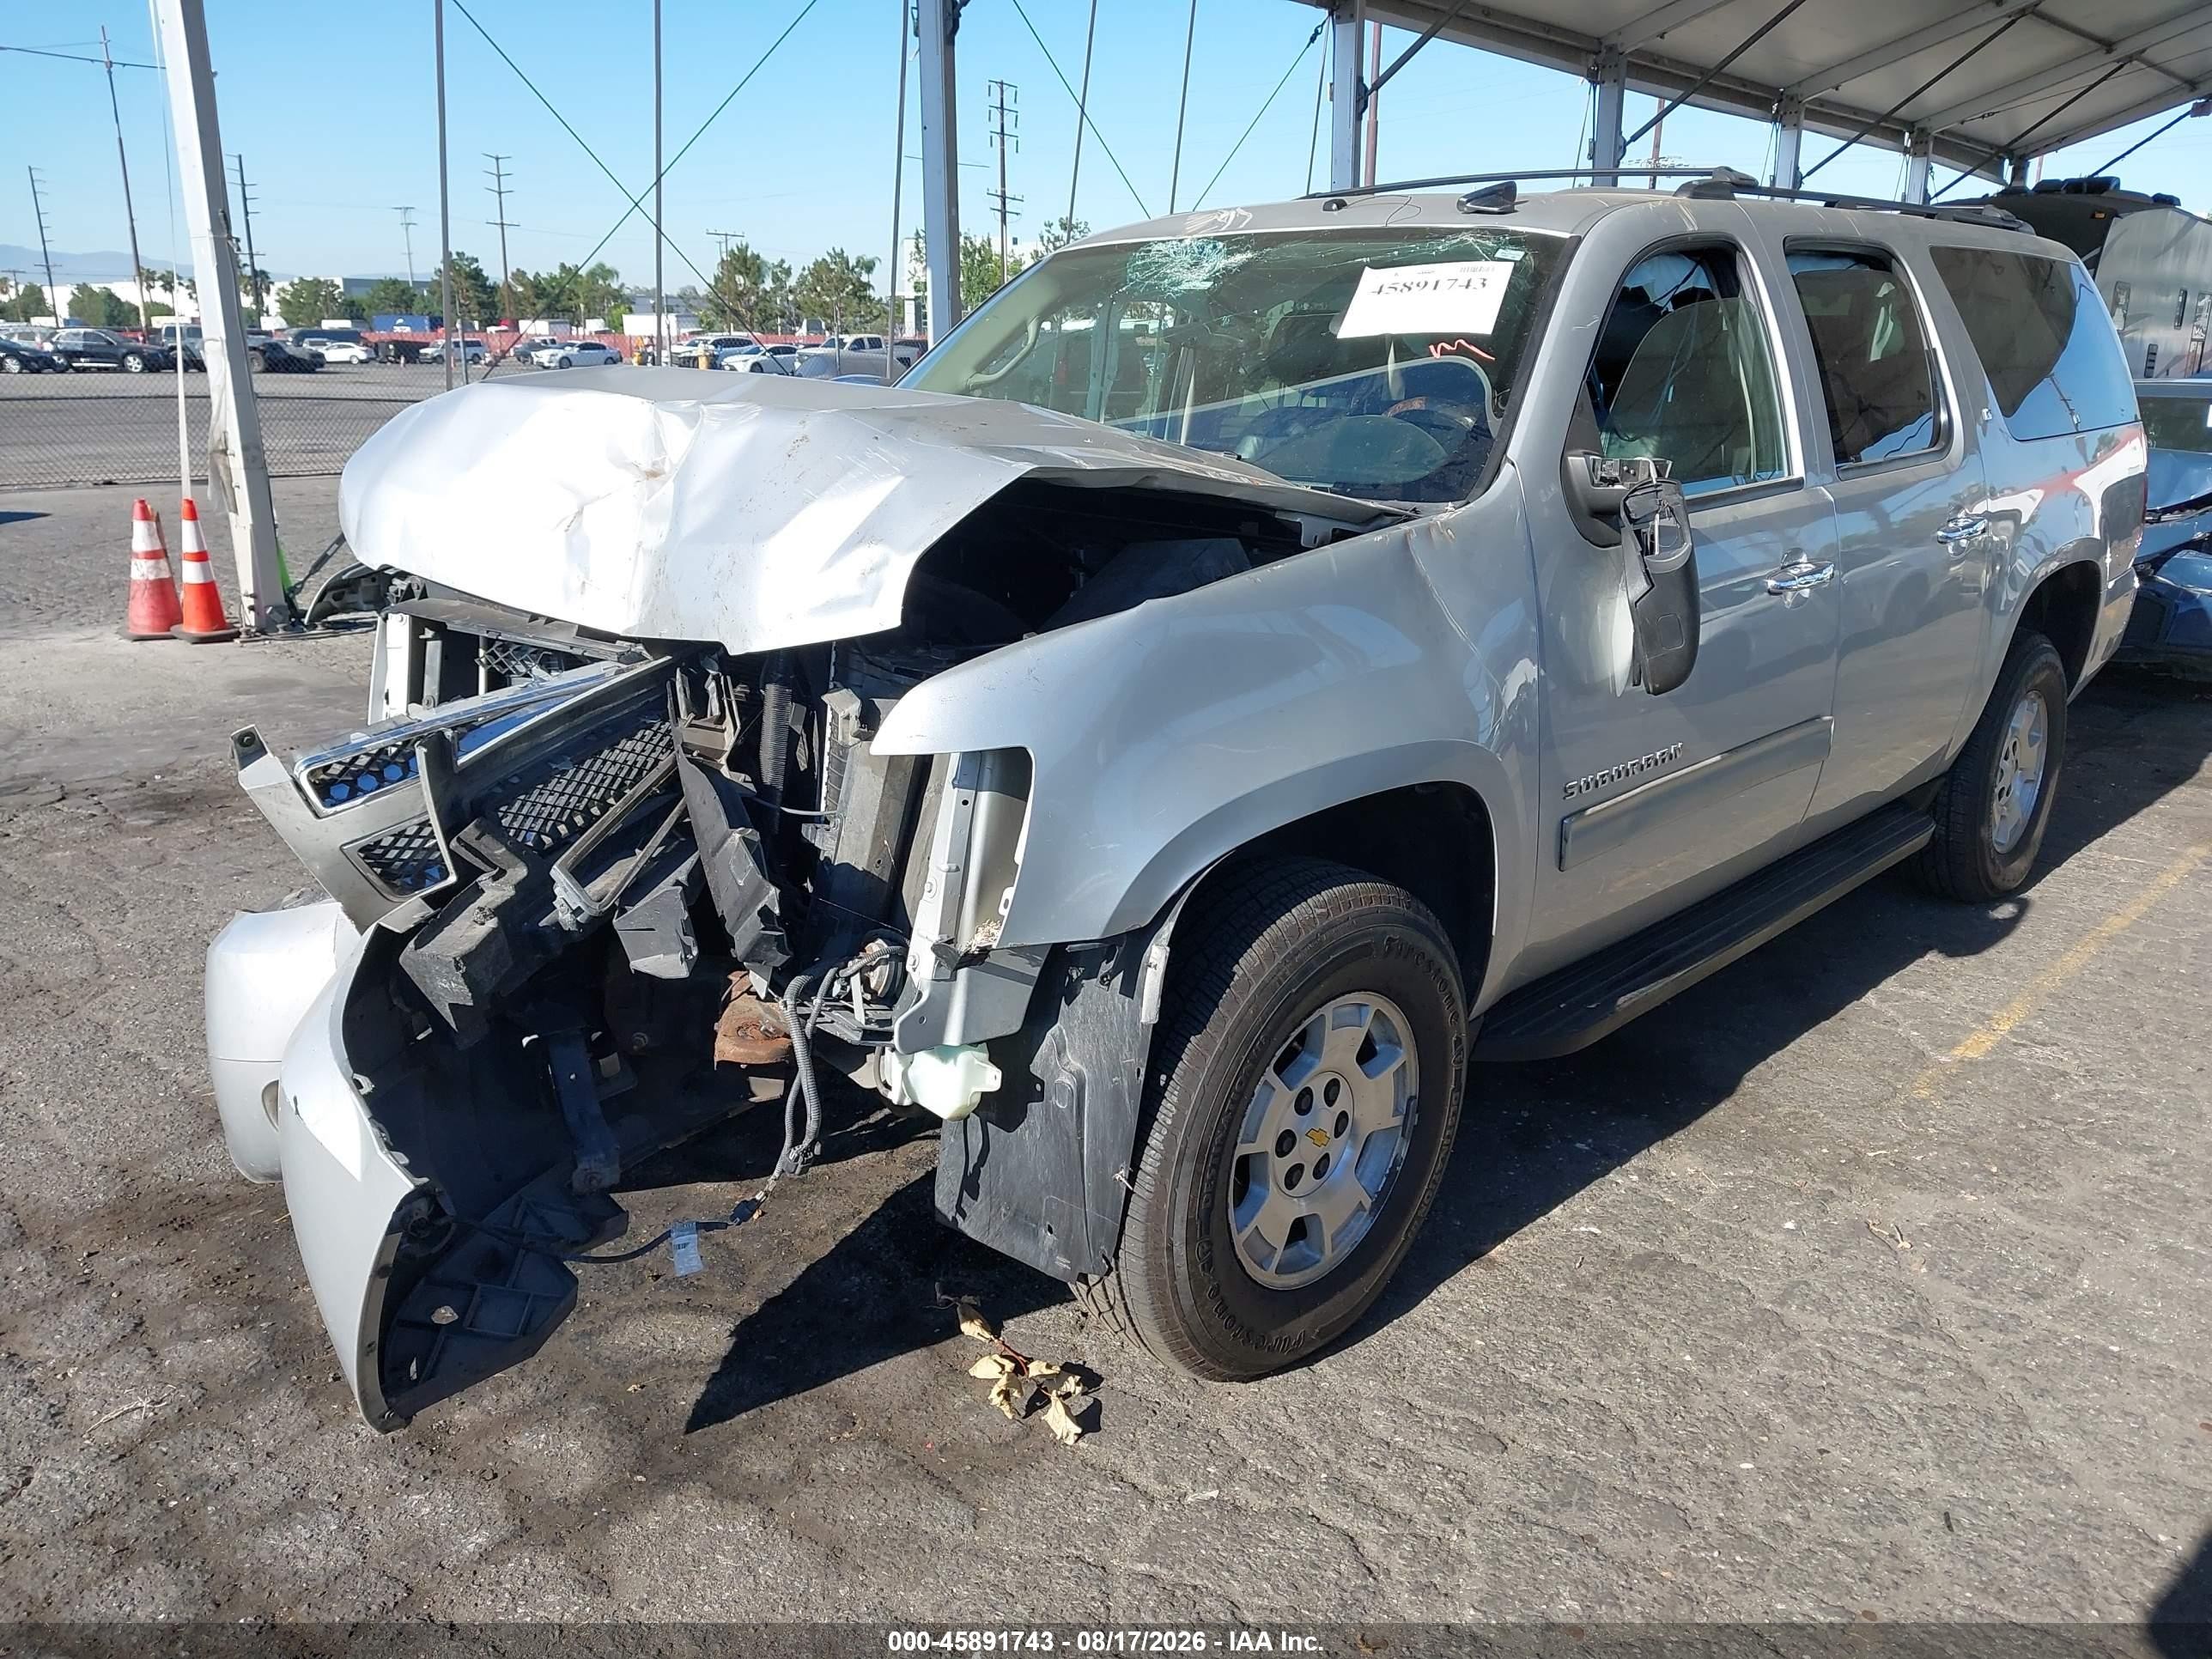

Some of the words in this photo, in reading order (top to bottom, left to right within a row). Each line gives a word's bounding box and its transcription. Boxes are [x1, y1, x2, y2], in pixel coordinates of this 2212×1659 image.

[1368, 276, 1487, 295] 45891743
[1563, 742, 1683, 800] SUBURBAN
[1383, 934, 1459, 1027] Firestone
[1206, 1282, 1305, 1355] Firestone
